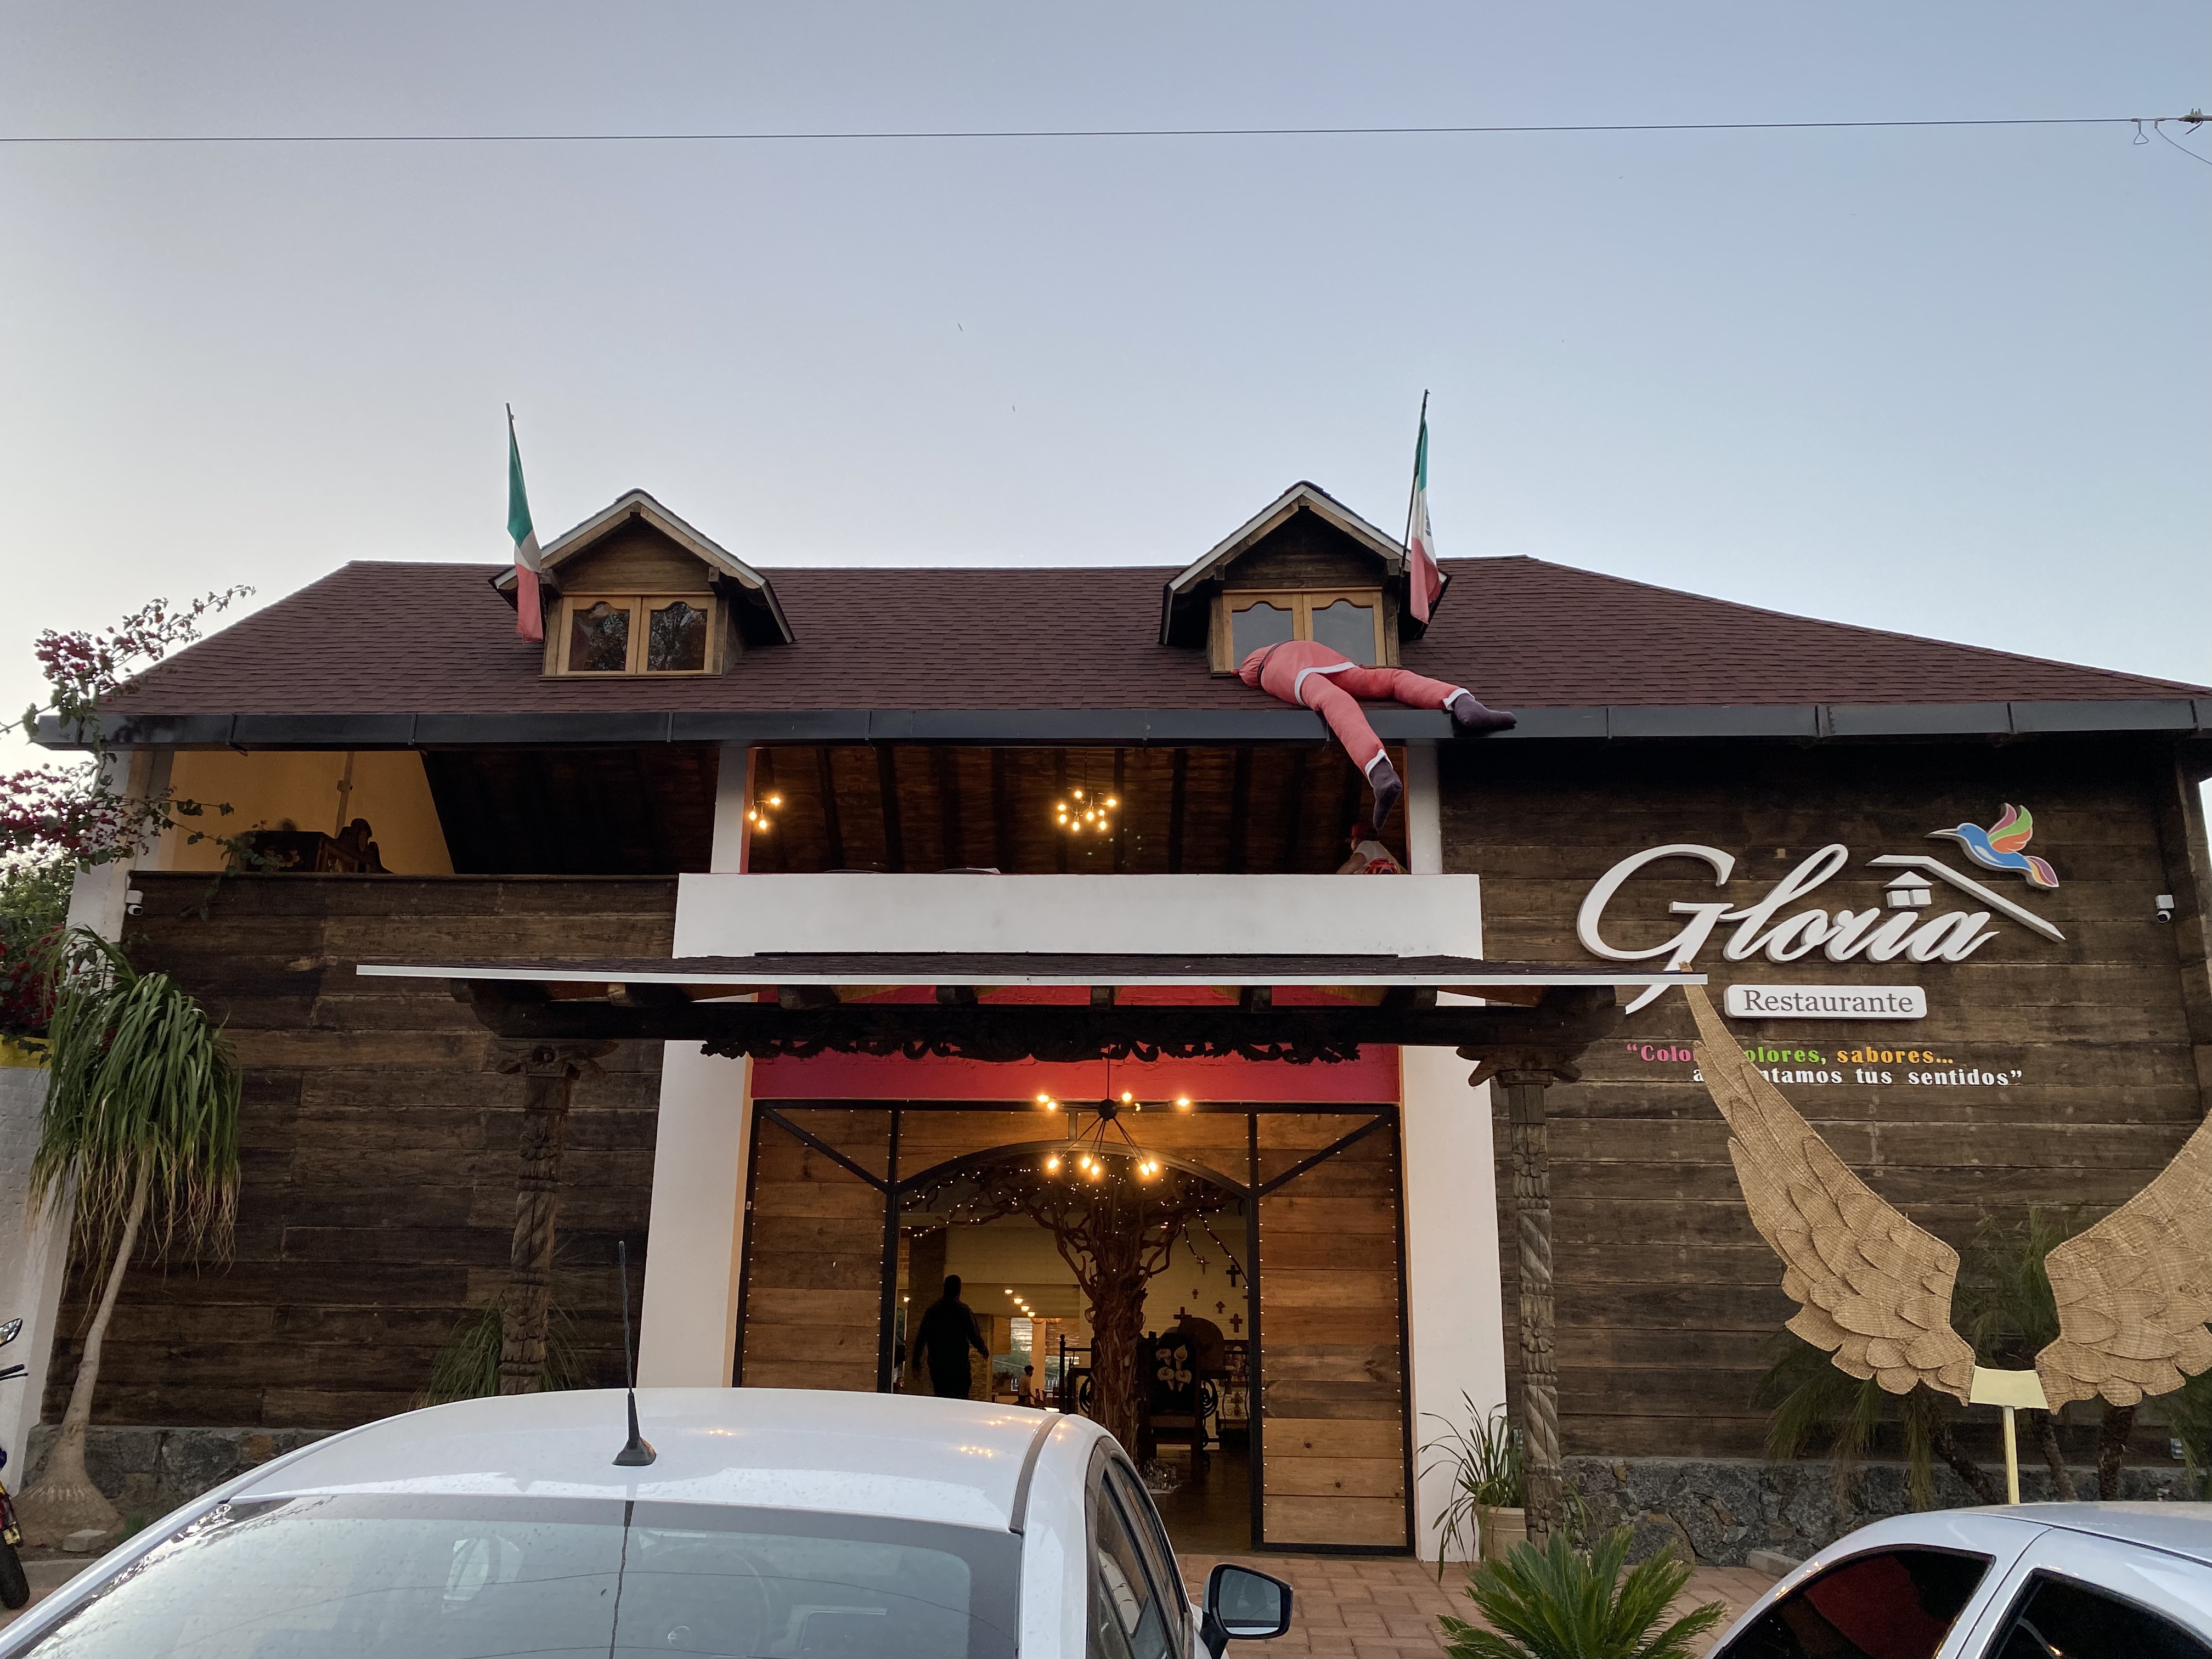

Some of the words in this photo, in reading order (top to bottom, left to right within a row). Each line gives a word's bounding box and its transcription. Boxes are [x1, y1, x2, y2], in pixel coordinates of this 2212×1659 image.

[1577, 843, 2000, 1015] Gloria
[1743, 990, 1914, 1013] Restaurante
[1626, 1043, 1697, 1062] “Colo
[1837, 1046, 1954, 1064] sabores...
[1693, 1068, 1843, 1084] antamos
[1855, 1068, 1893, 1084] tus
[1908, 1068, 2022, 1086] sentidos”
